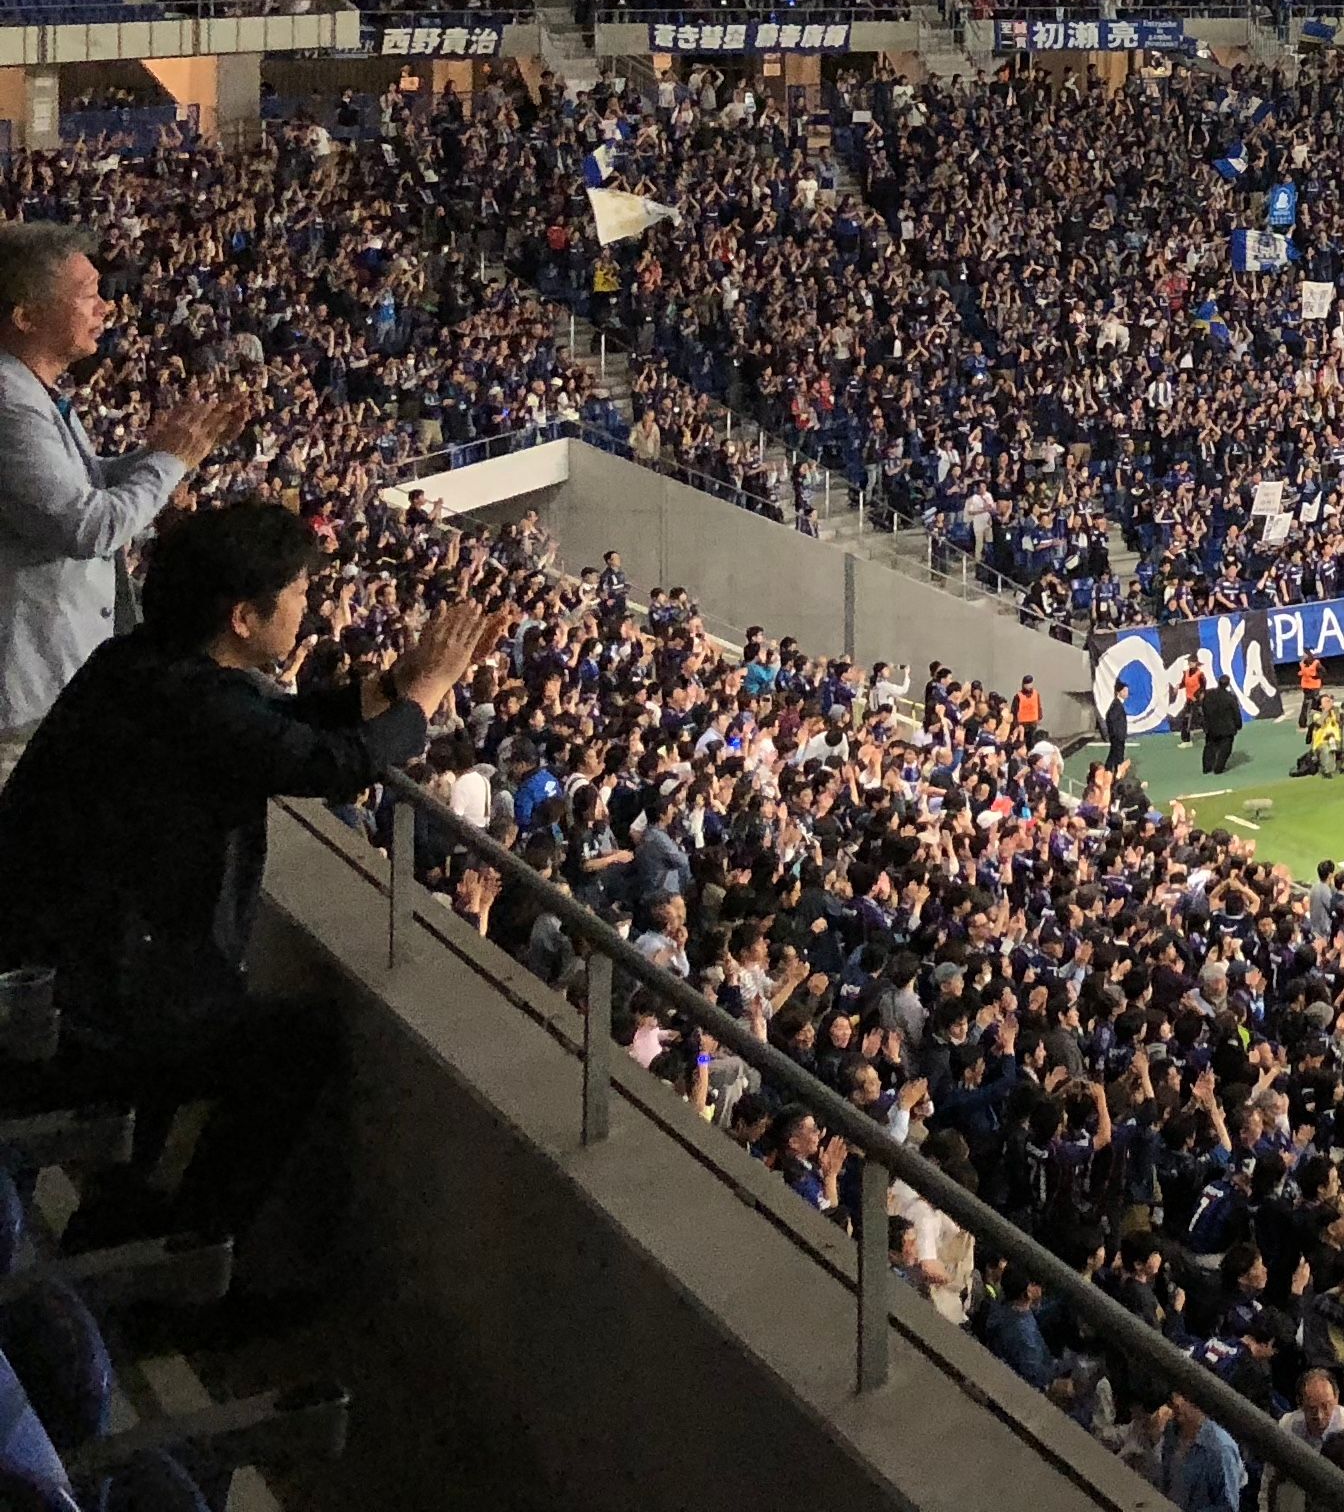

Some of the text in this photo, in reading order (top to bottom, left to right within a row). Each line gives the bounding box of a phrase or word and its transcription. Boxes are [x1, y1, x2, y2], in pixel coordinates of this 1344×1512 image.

[382, 27, 499, 56] 西野貴治
[1033, 21, 1100, 50] 初瀬
[1107, 21, 1139, 49] 亮
